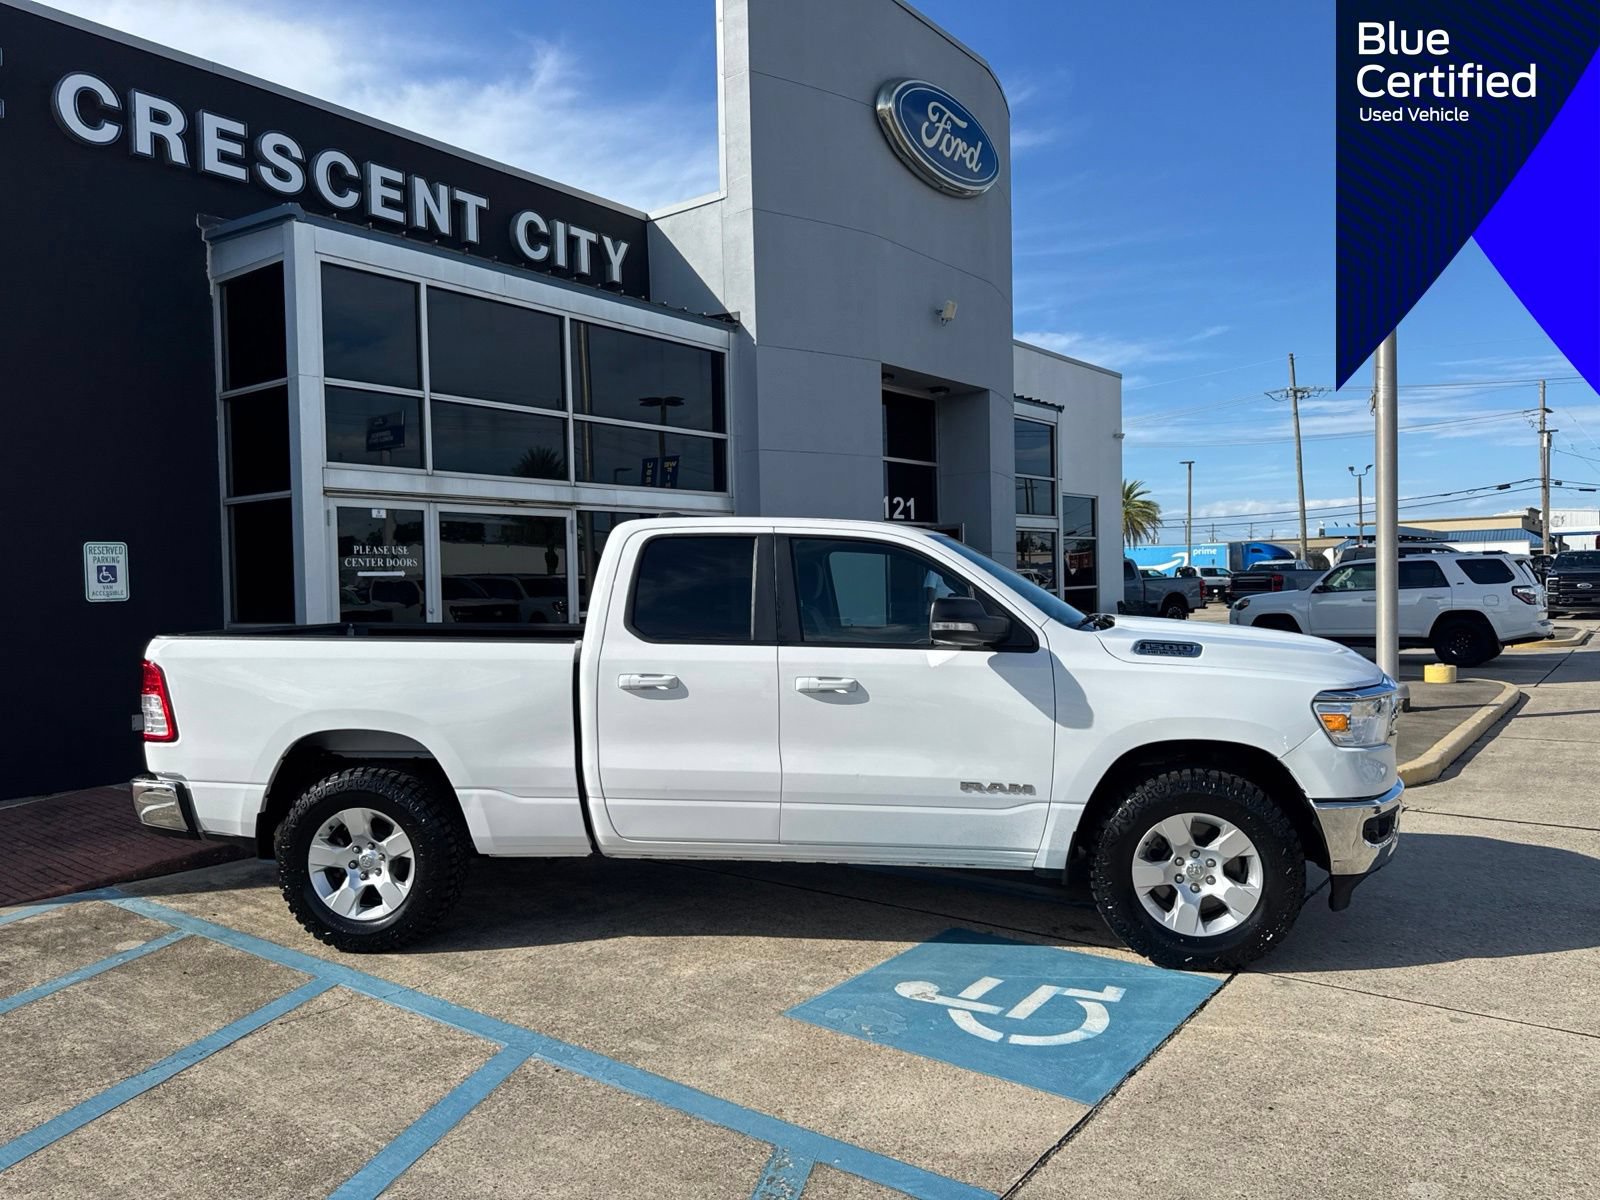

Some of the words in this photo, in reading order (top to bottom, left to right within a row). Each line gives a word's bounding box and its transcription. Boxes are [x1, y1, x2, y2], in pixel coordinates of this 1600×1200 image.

[921, 101, 983, 173] Ford
[52, 71, 489, 245] CRESCENT
[510, 209, 631, 284] CITY
[883, 495, 915, 520] 121
[88, 545, 124, 555] RESERVED
[353, 545, 390, 555] PLEASE
[391, 545, 409, 555] USE
[1193, 547, 1217, 557] prime
[92, 556, 120, 564] PARKING
[344, 557, 385, 568] CENTER
[386, 557, 418, 568] DOORS
[960, 782, 1036, 795] RAM
